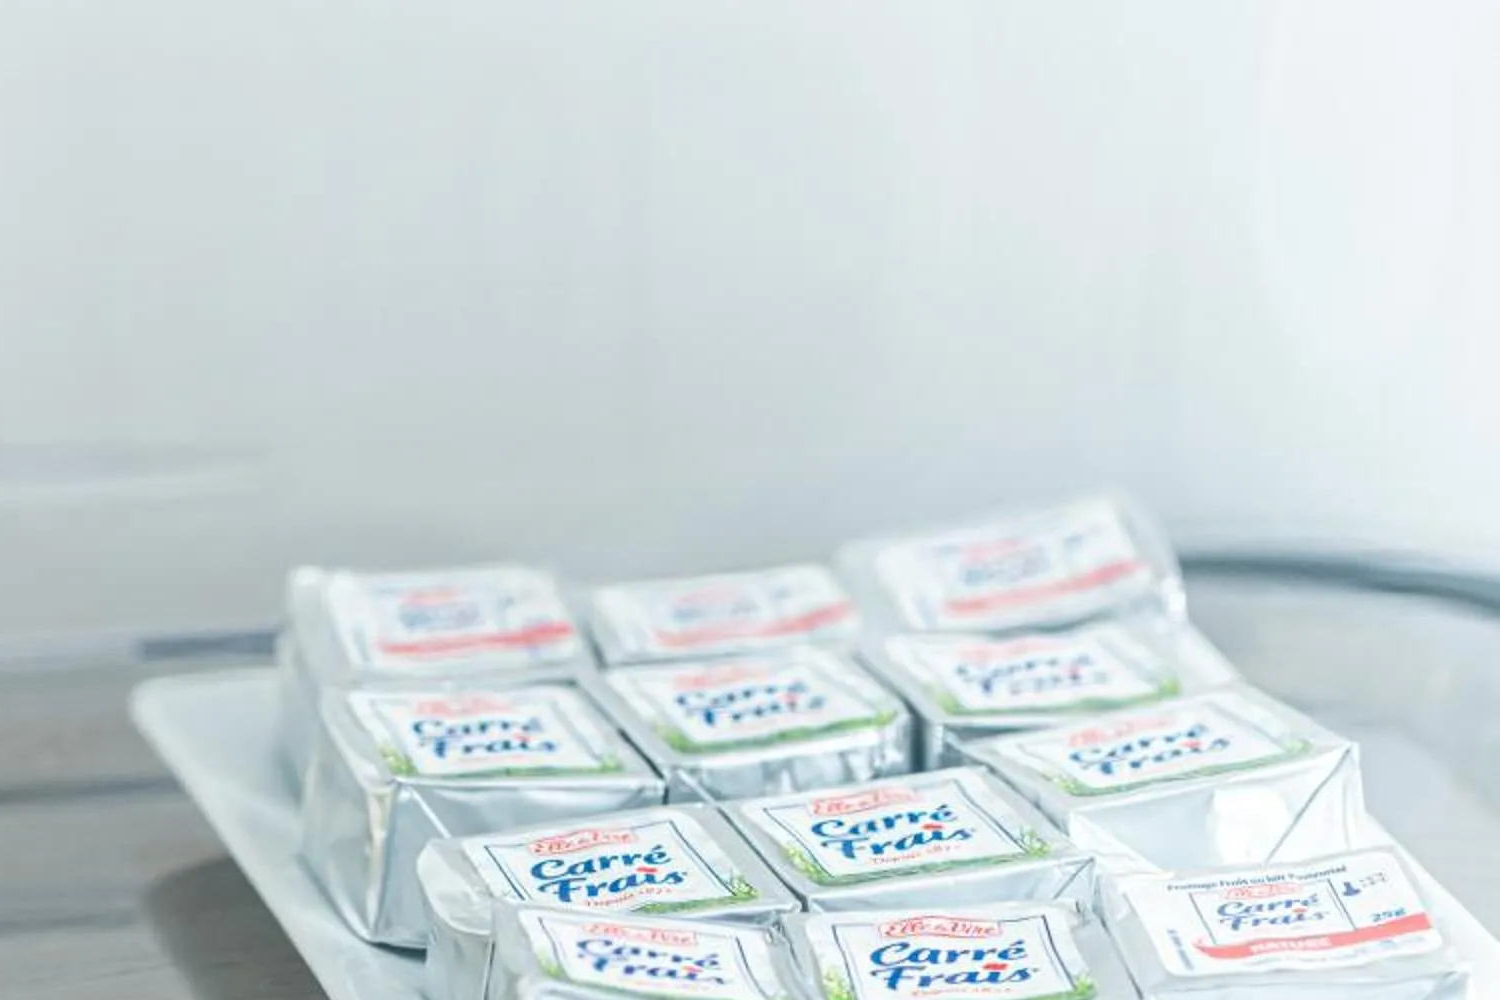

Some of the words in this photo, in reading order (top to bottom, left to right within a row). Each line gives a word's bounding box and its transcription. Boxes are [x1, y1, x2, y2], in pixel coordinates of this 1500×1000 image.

[412, 717, 543, 741] Carré
[1069, 723, 1209, 764] Carré
[811, 803, 958, 838] Carré
[820, 823, 972, 859] Frais
[530, 844, 671, 880] Carré
[538, 866, 684, 902] Frais
[1217, 893, 1319, 918] Carré
[1219, 908, 1325, 931] Frais
[576, 938, 722, 970] Carré
[577, 953, 726, 985] Frais
[870, 940, 1028, 966] Carré
[870, 962, 1032, 991] Frais
